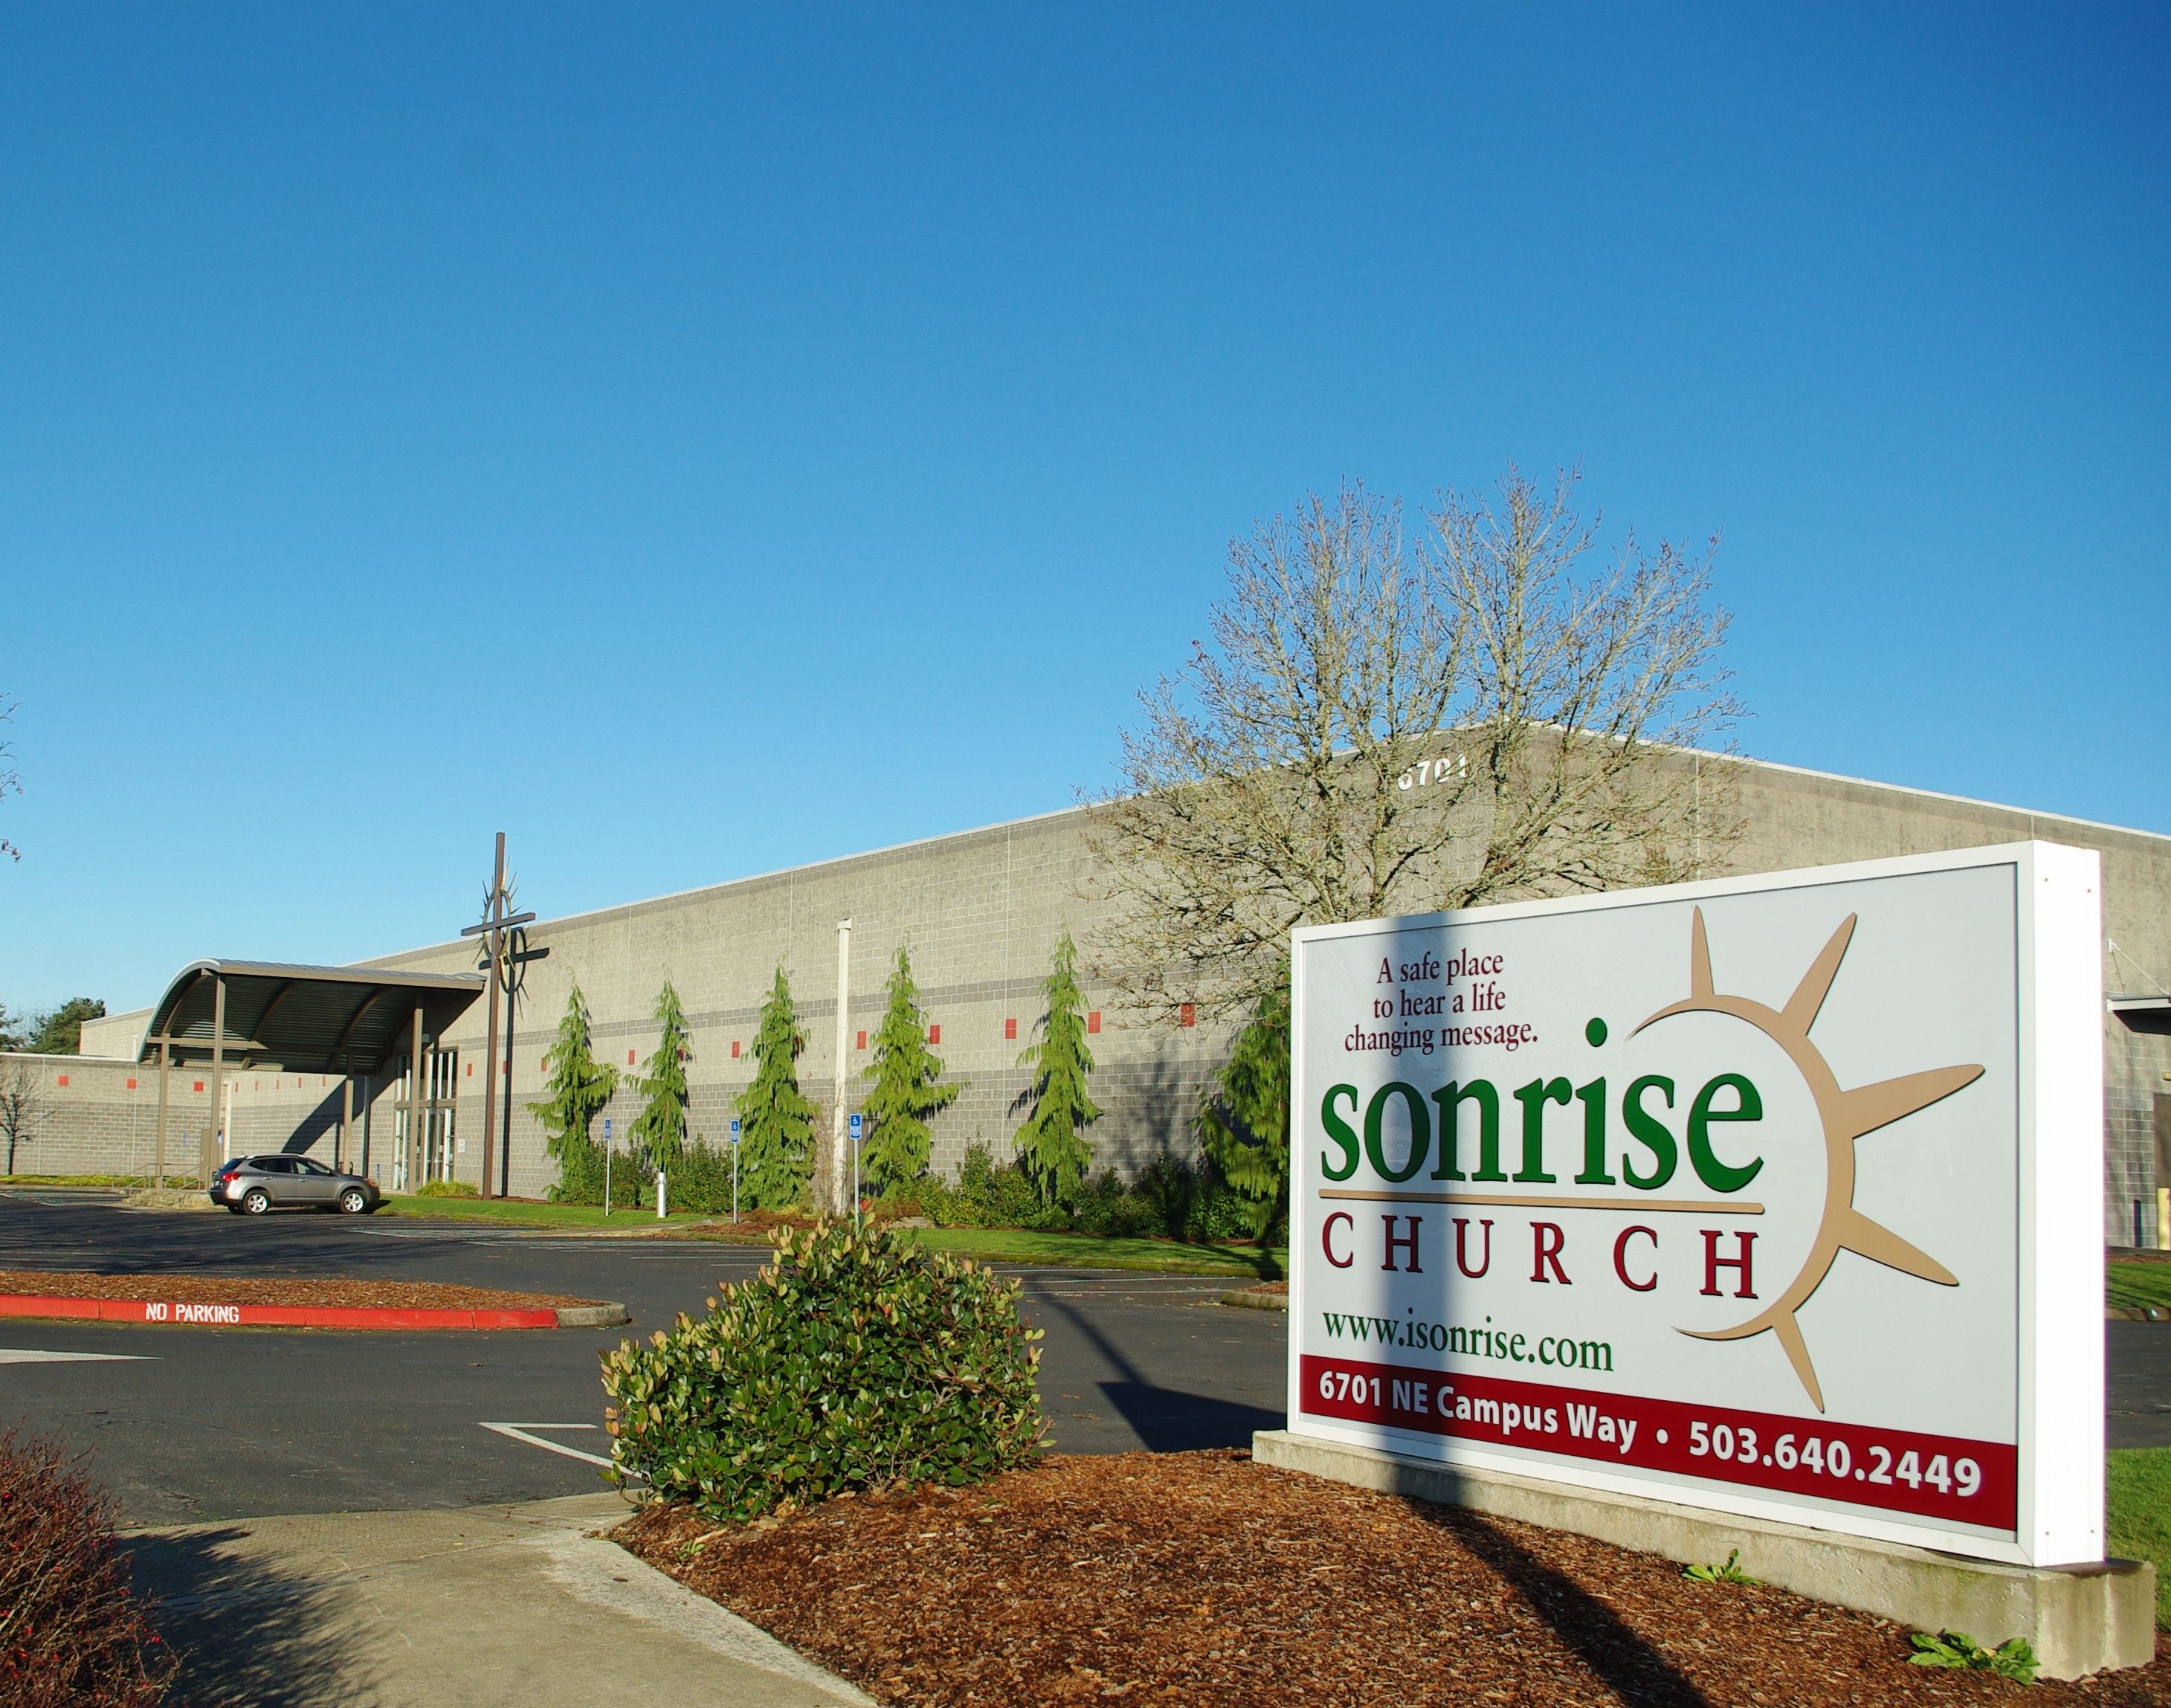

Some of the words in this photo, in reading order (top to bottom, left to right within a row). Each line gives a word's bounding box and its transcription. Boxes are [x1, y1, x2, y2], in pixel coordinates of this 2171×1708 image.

[1375, 956, 1394, 984] A
[1400, 950, 1440, 982] safe
[1445, 947, 1504, 986] place
[1373, 997, 1393, 1019] to
[1399, 988, 1446, 1016] hear
[1451, 994, 1465, 1013] a
[1471, 981, 1506, 1012] life
[1344, 1021, 1435, 1057] changing
[1440, 1022, 1538, 1051] message.
[1320, 1016, 1764, 1193] sonrise
[1321, 1211, 1760, 1300] CHURCH
[145, 1302, 168, 1321] NO
[175, 1303, 239, 1323] PARKING
[1323, 1306, 1615, 1372] www.isonrise.com
[1318, 1370, 1381, 1407] 6701
[1391, 1378, 1429, 1414] NE
[1436, 1385, 1559, 1435] Campus
[1565, 1402, 1638, 1454] Way
[1688, 1419, 1982, 1498] 503.640.2449
